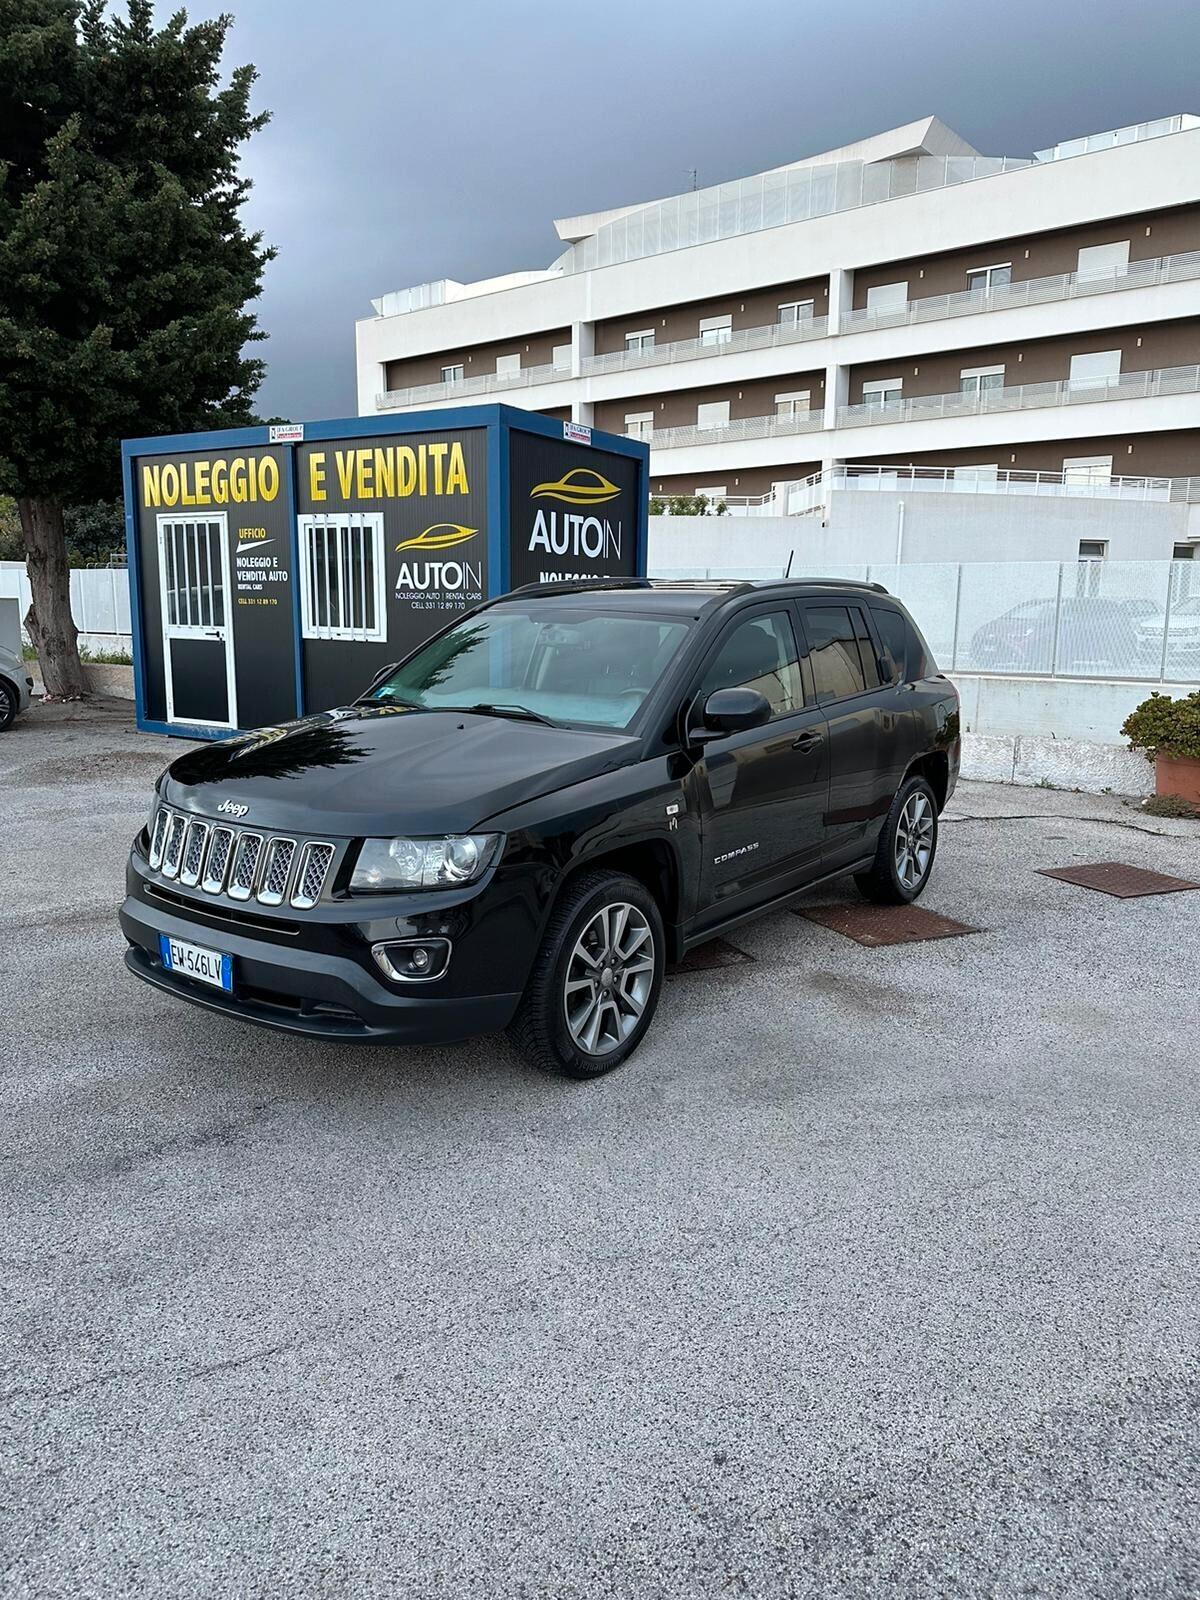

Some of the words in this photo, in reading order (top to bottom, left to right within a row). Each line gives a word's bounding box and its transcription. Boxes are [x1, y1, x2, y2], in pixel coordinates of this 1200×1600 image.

[142, 455, 280, 507] NOLEGGIO
[309, 452, 327, 501] E
[335, 441, 470, 499] VENDITA
[238, 528, 266, 539] UFFICIO
[528, 509, 621, 560] AUTOIN
[236, 557, 271, 568] NOLEGGIO
[273, 557, 278, 567] E
[237, 570, 267, 581] VENDITA
[268, 570, 288, 581] AUTO
[395, 561, 482, 590] AUTOIN
[395, 592, 425, 600] NOLEGGIO
[425, 592, 440, 600] AUTO
[445, 592, 465, 600] RENTAL
[465, 592, 482, 600] CARS
[411, 601, 424, 609] CELL
[425, 601, 435, 609] 331
[454, 602, 465, 610] 170
[217, 799, 249, 818] Jeep
[713, 842, 759, 865] COMPASS
